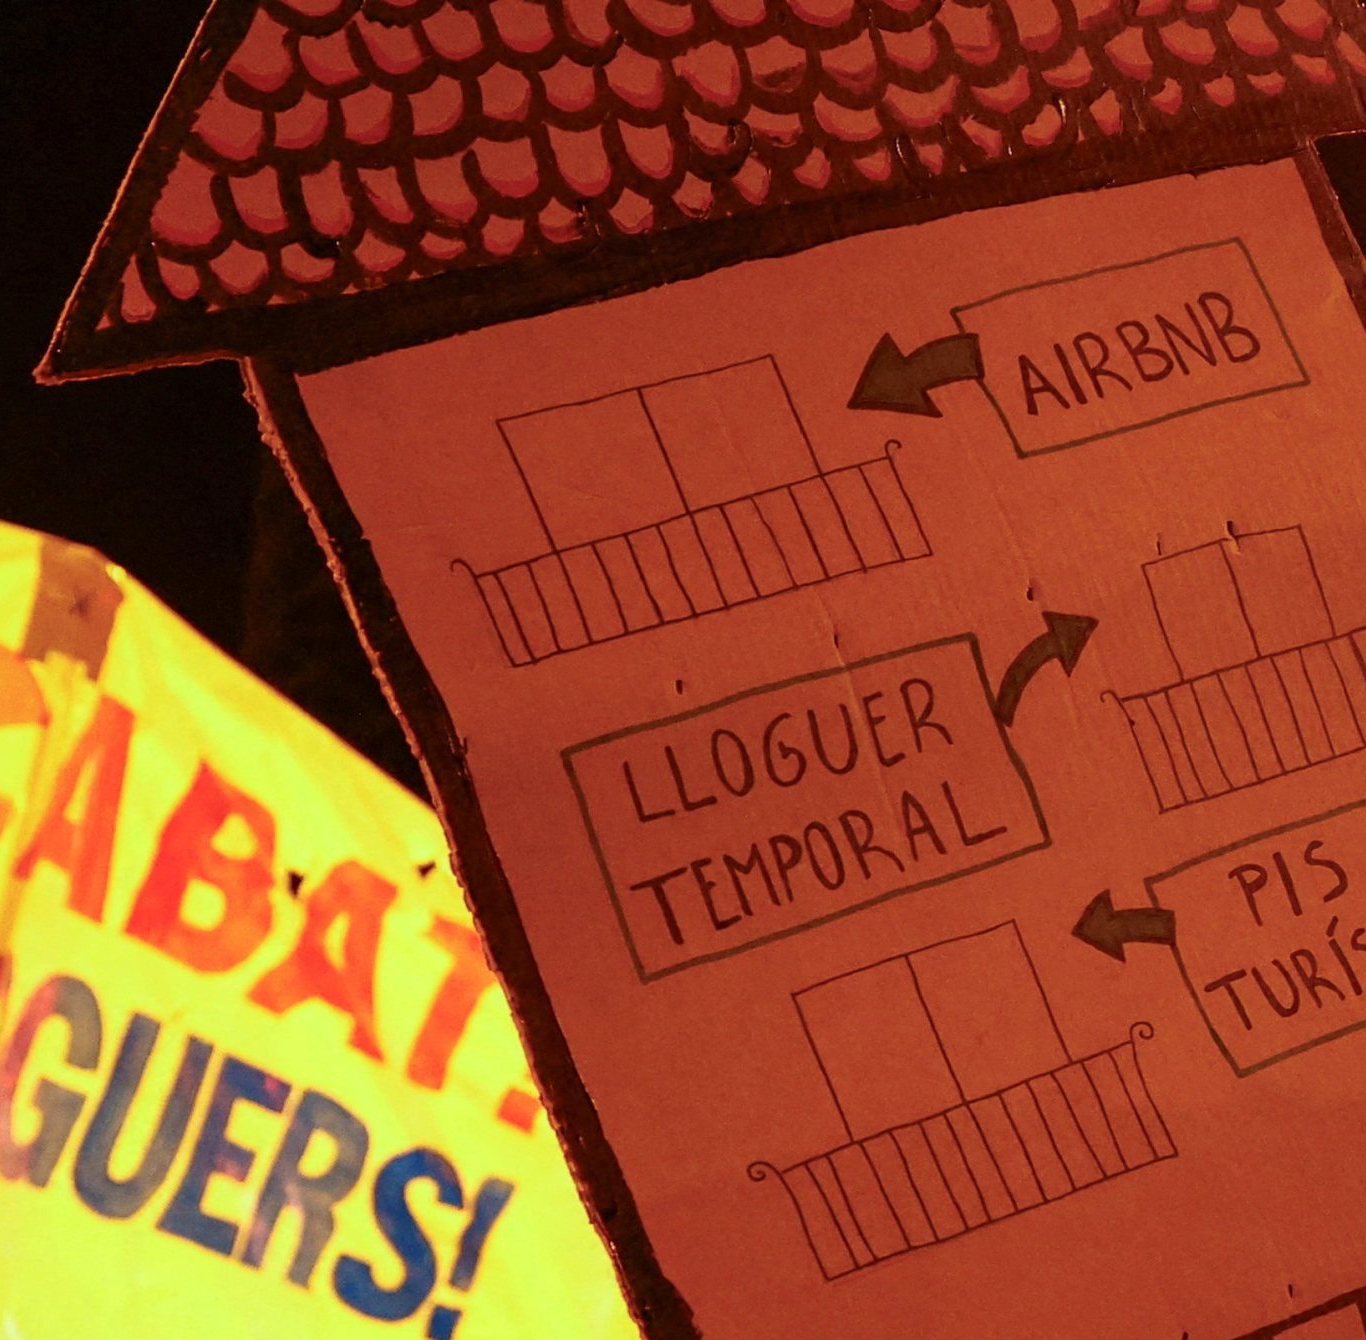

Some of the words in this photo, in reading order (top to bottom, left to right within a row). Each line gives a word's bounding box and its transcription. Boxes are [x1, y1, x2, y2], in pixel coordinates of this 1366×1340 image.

[1017, 290, 1260, 416] AIRBNB
[621, 678, 954, 825] LLOGUER
[629, 780, 1008, 948] TEMPORAL
[1229, 840, 1350, 928] PIS
